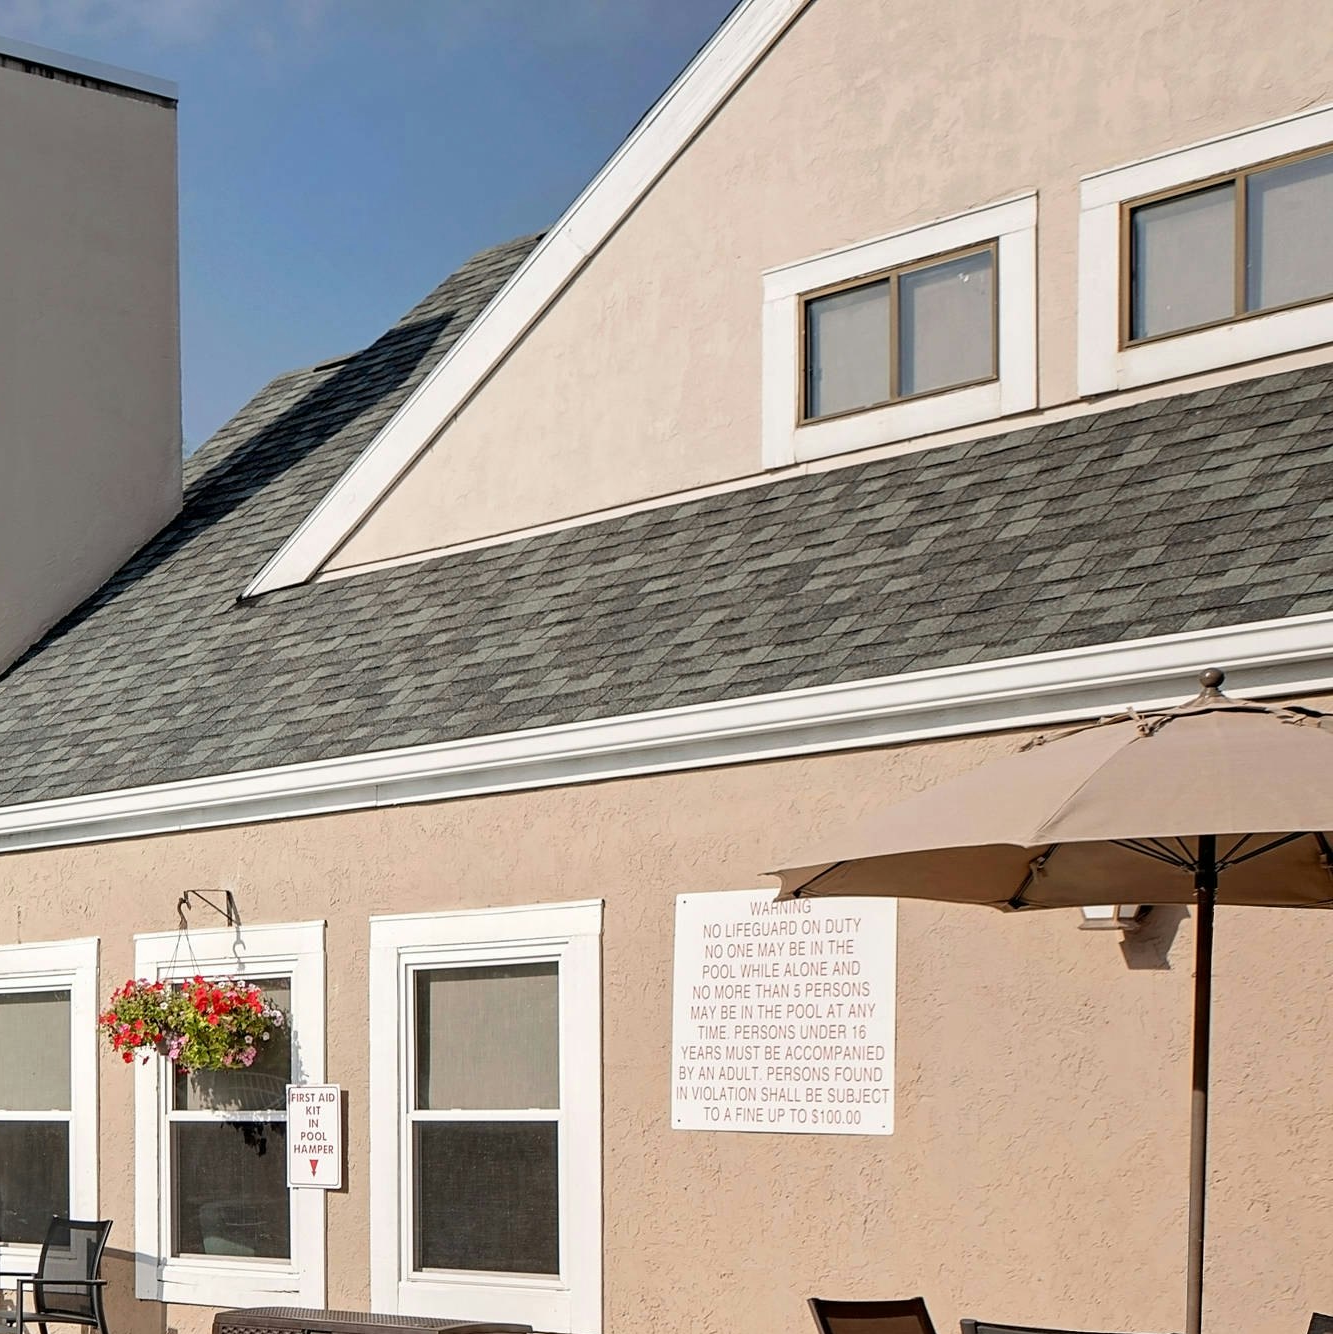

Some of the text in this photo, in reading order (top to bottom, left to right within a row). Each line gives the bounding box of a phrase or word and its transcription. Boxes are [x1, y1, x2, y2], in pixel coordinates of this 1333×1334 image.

[750, 899, 811, 915] WARNING
[703, 918, 862, 938] NO LIFEGUARD ON DUTY
[705, 940, 854, 958] NO ONE MAY BE IN THE
[702, 961, 861, 979] POOL WHILE ALONE AND
[693, 982, 870, 999] NO MORE THAN 5 PERSONS
[690, 1004, 876, 1020] MAY BE IN THE POOL AT ANY
[698, 1025, 866, 1039] TIME. PERSONS UNDER 16
[681, 1046, 885, 1061] YEARS MUST BE ACCOMPANIED
[679, 1066, 882, 1082] BY AN ADULT. PERSONS FOUND
[291, 1093, 335, 1102] FIRST AID
[676, 1086, 890, 1104] IN VIOLATION SHALL BE SUBJECT
[306, 1106, 321, 1115] KIT
[704, 1107, 861, 1125] TO A FINE UP TO $100.00
[309, 1119, 318, 1128] IN
[301, 1132, 327, 1141] POOL
[293, 1145, 334, 1154] HAMPER
